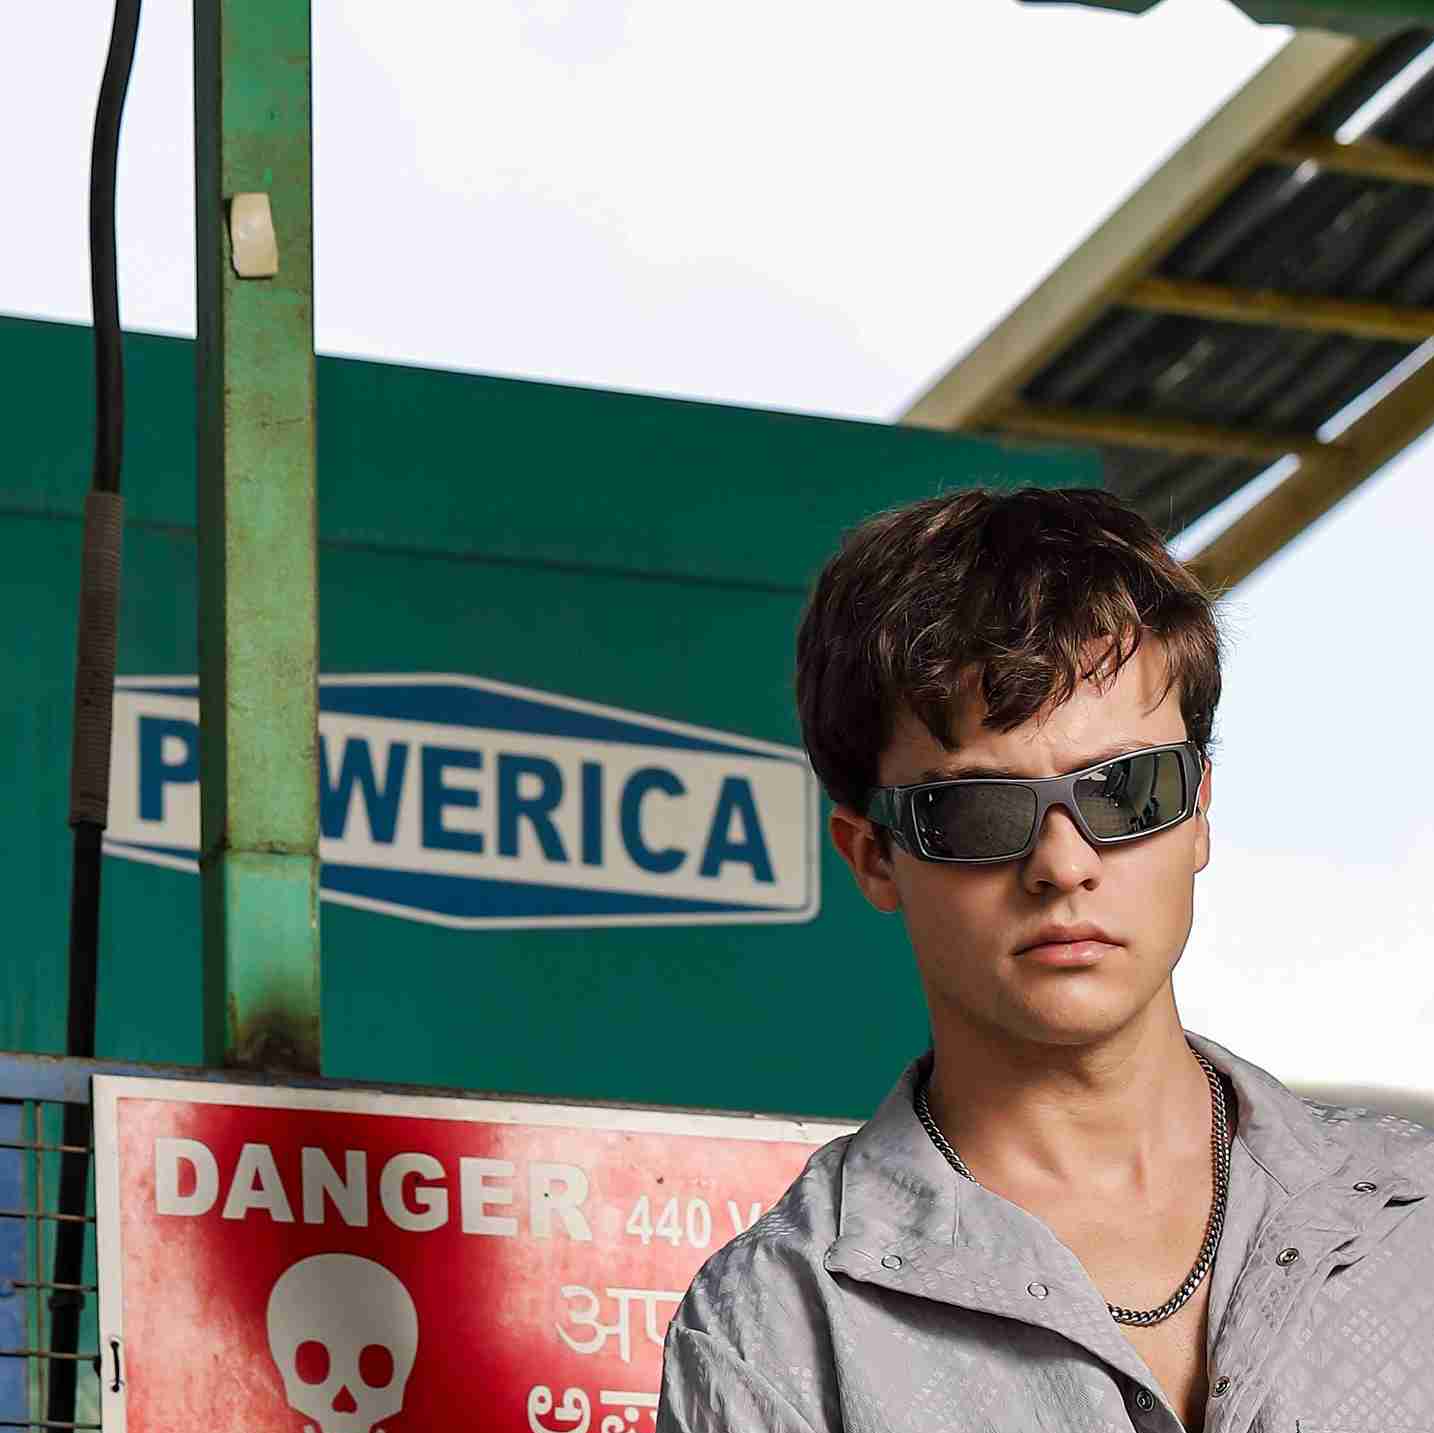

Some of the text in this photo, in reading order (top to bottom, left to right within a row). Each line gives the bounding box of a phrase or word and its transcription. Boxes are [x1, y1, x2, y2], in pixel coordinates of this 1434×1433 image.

[137, 715, 775, 884] PWERICA
[153, 1137, 594, 1243] DANGER
[625, 1195, 713, 1249] 440
